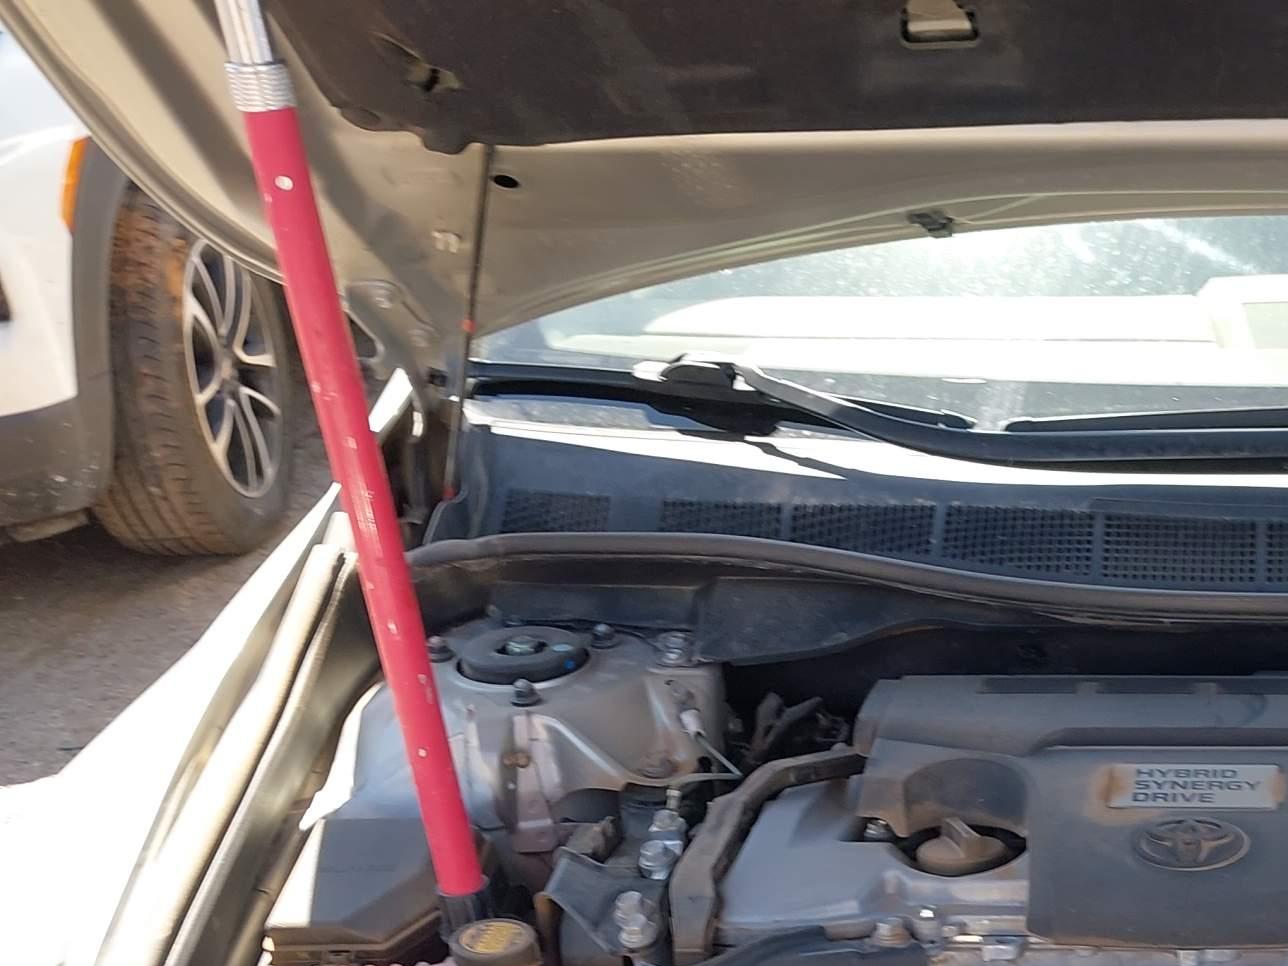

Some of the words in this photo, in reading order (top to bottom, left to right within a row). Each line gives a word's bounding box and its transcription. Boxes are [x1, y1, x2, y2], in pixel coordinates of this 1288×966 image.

[1135, 768, 1239, 779] HYBRID
[1134, 780, 1261, 791] SYNERGY
[1132, 792, 1216, 803] DRIVE
